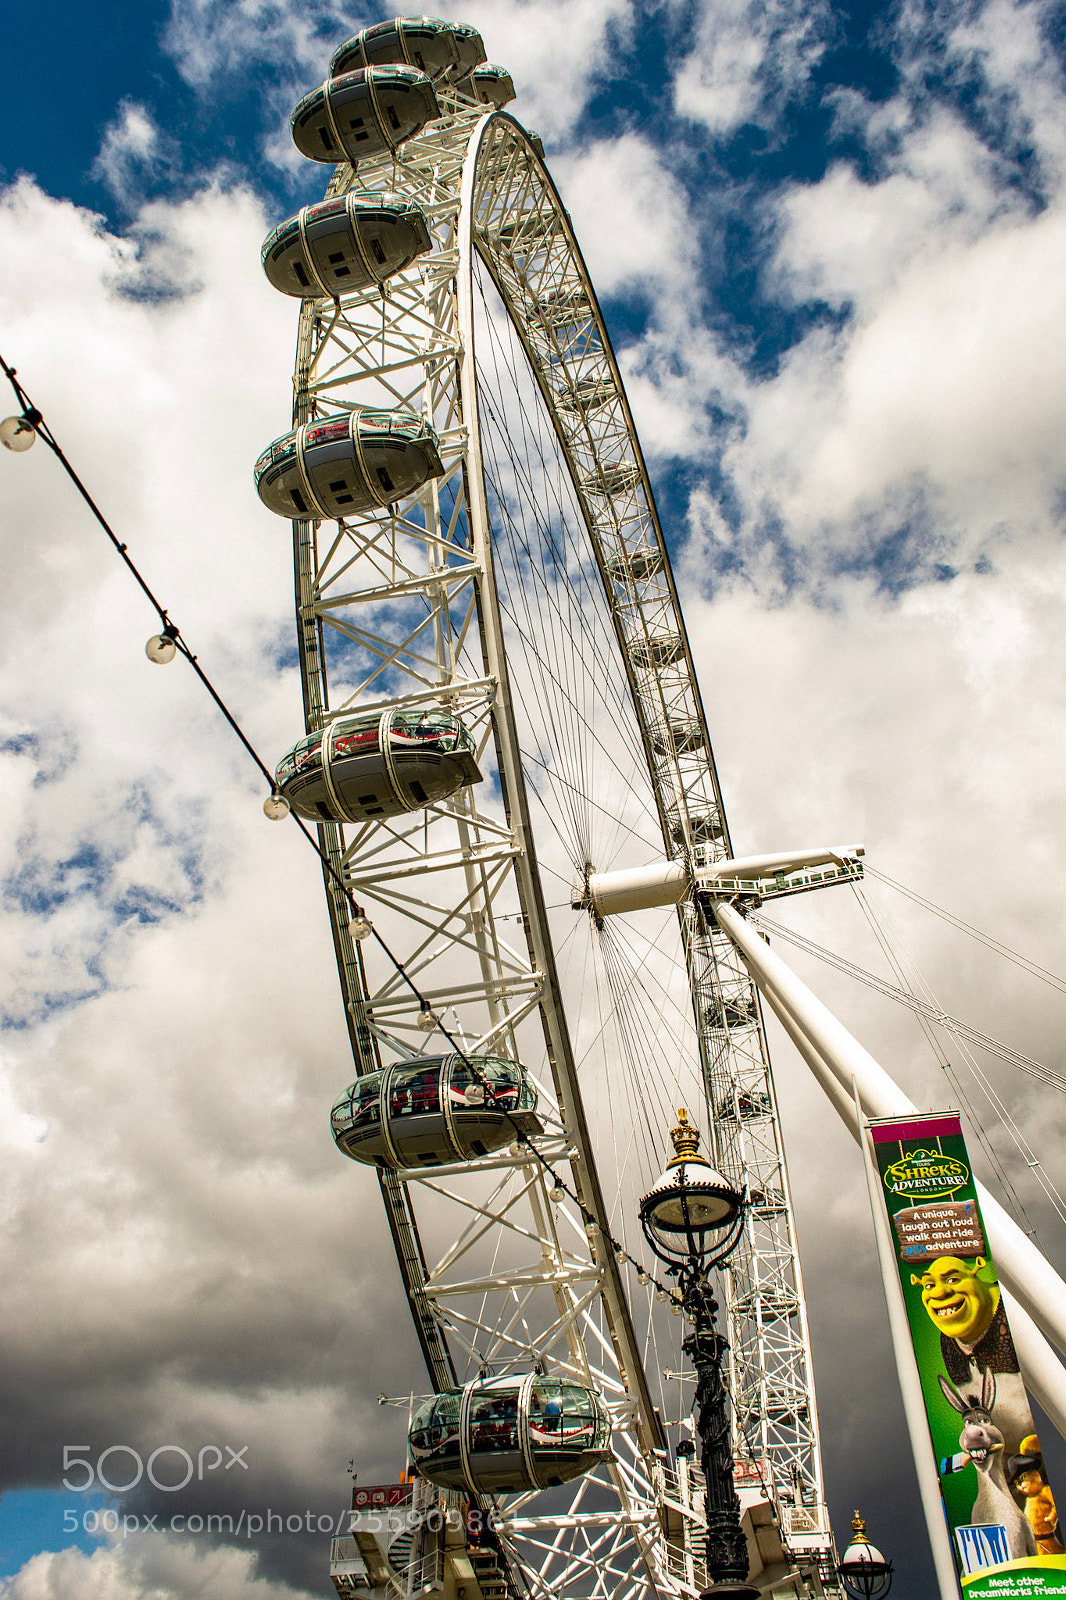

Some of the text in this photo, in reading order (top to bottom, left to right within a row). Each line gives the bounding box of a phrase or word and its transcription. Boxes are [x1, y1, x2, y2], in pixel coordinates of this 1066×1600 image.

[890, 1176, 967, 1193] ADVENTURE!
[913, 1210, 957, 1220] A unique,
[901, 1217, 974, 1231] laugh out loud
[905, 1228, 974, 1242] walk and ride
[988, 1577, 1045, 1587] Meet other
[968, 1588, 1032, 1598] DreamWorks
